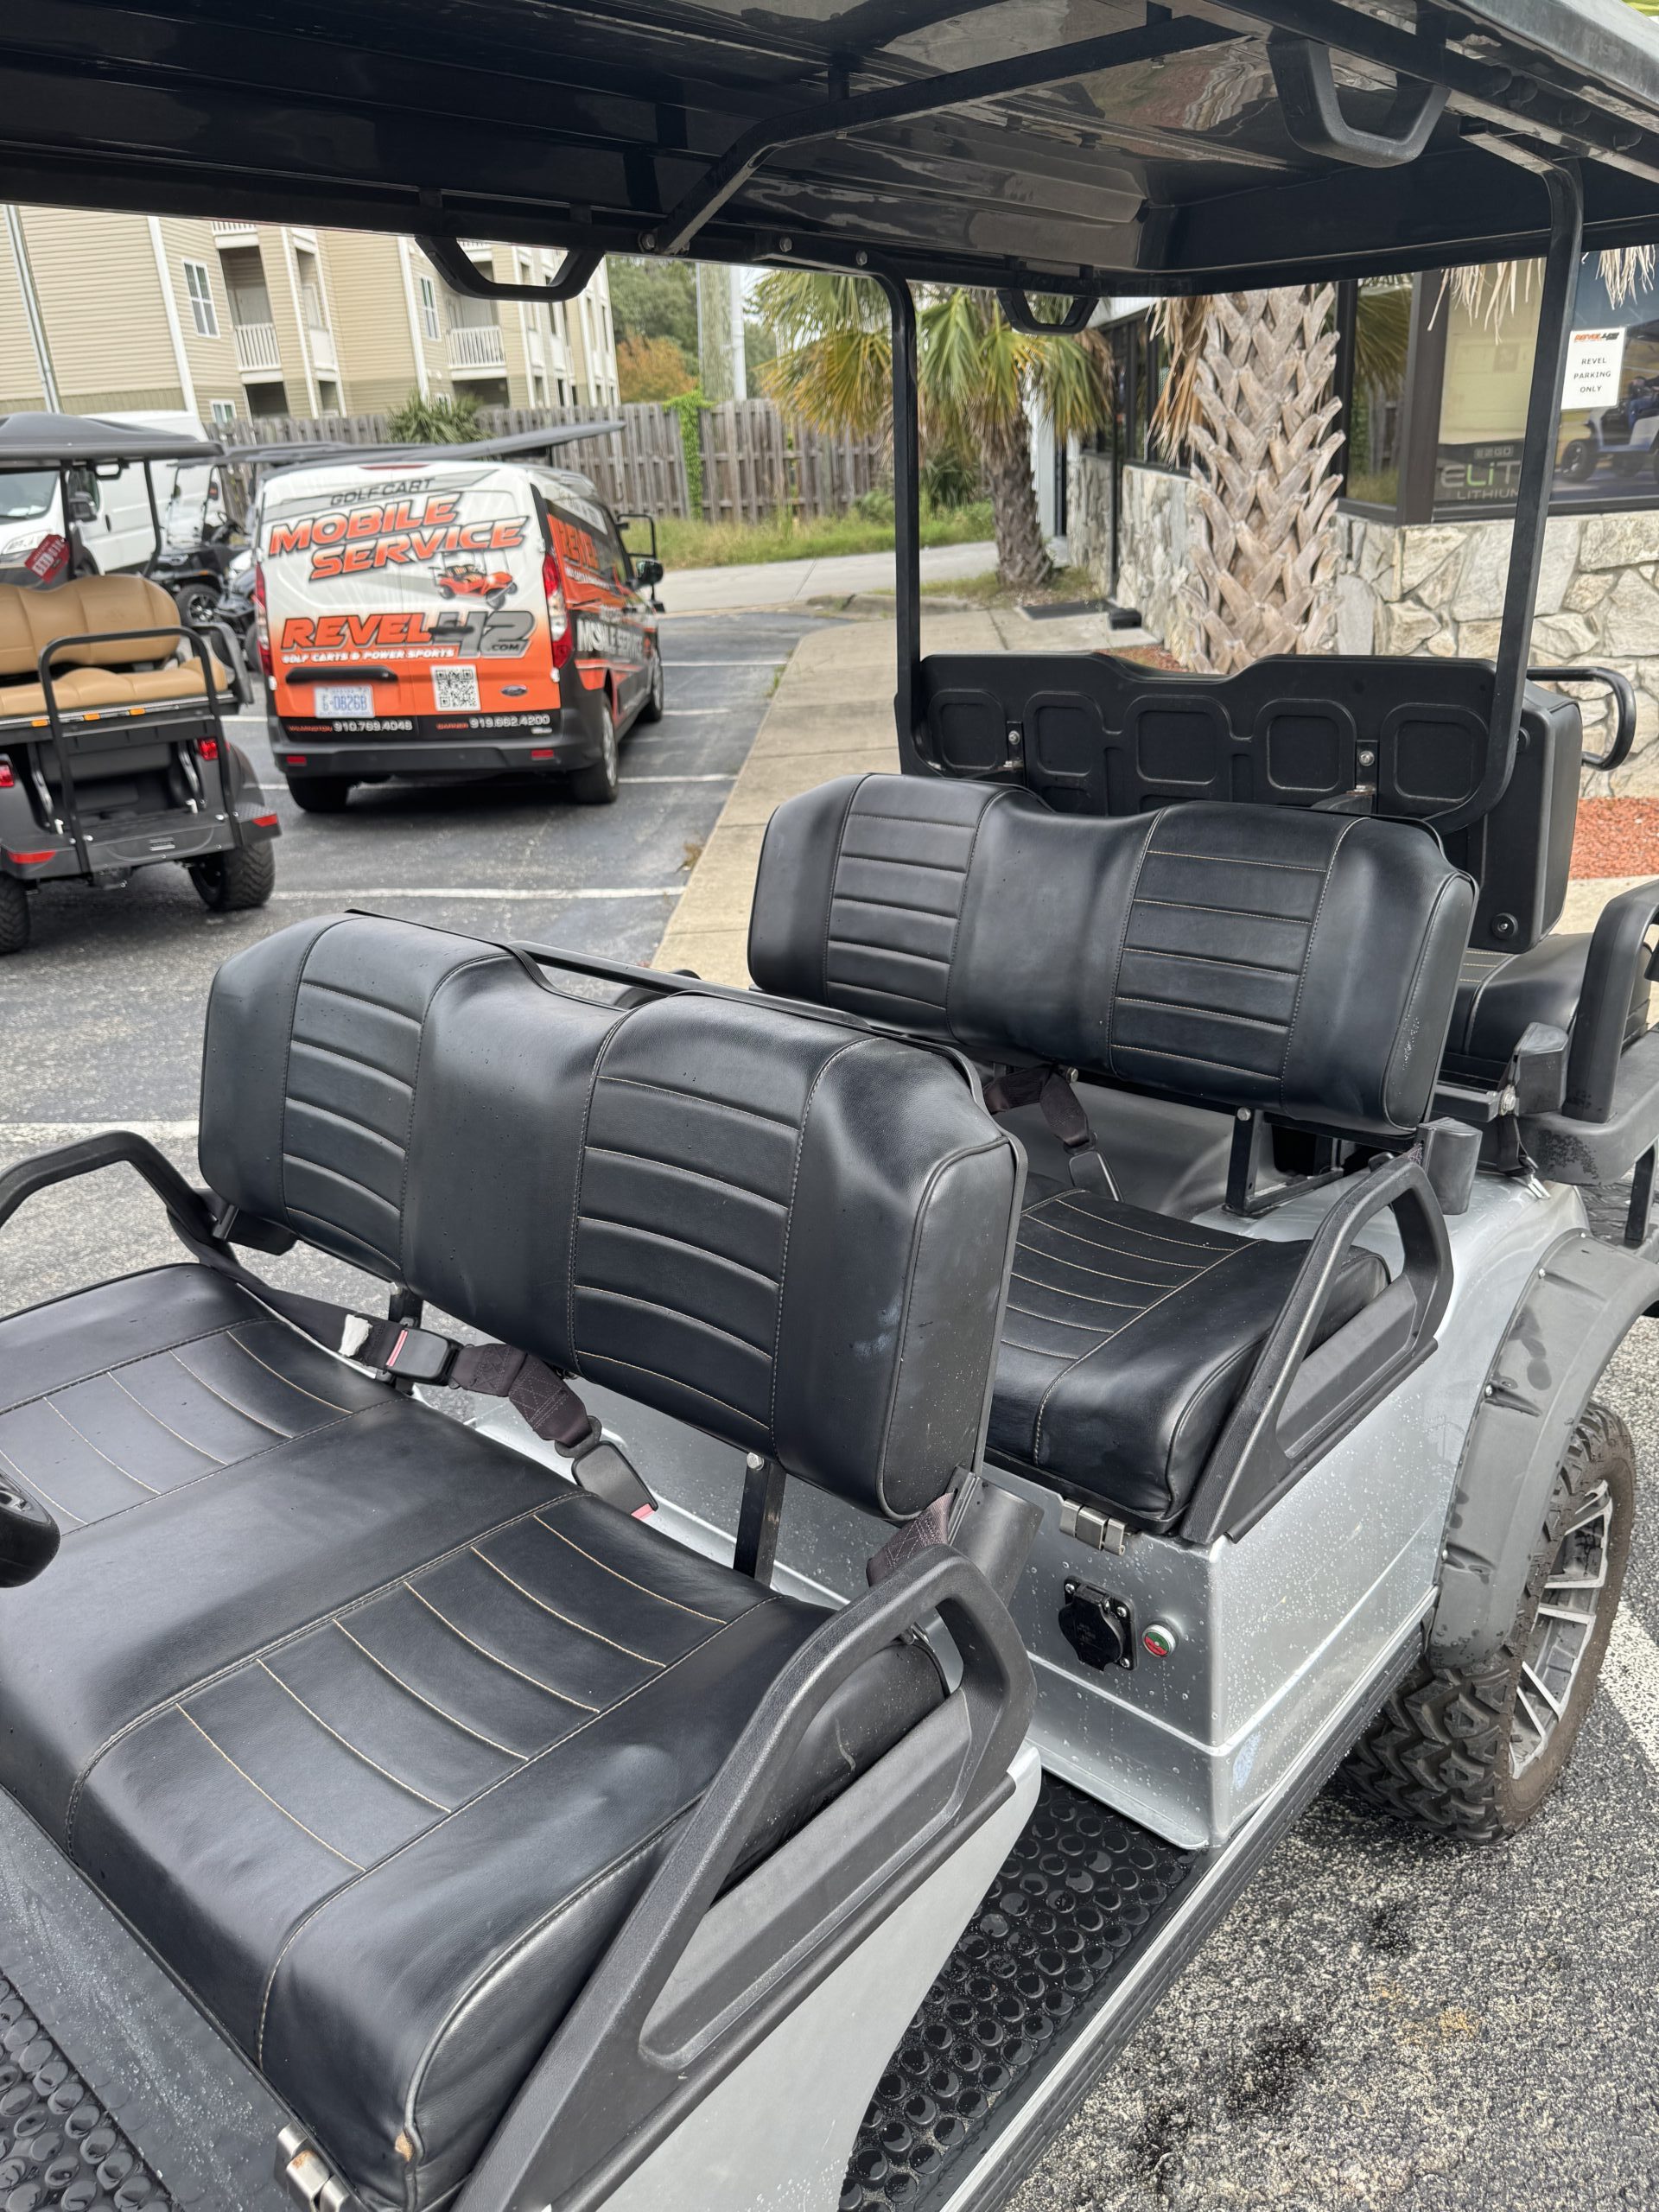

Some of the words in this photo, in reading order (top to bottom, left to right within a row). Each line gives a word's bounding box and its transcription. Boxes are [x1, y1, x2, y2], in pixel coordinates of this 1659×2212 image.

[1581, 357, 1607, 365] REVEL
[1573, 371, 1611, 380] PARKING
[1580, 385, 1602, 394] ONLY
[268, 491, 463, 557] MOBILE
[308, 515, 530, 582] SERVICE
[282, 654, 309, 664] GOLF
[311, 651, 348, 662] CARTS
[363, 649, 404, 659] POWER
[406, 648, 454, 658] SPORTS
